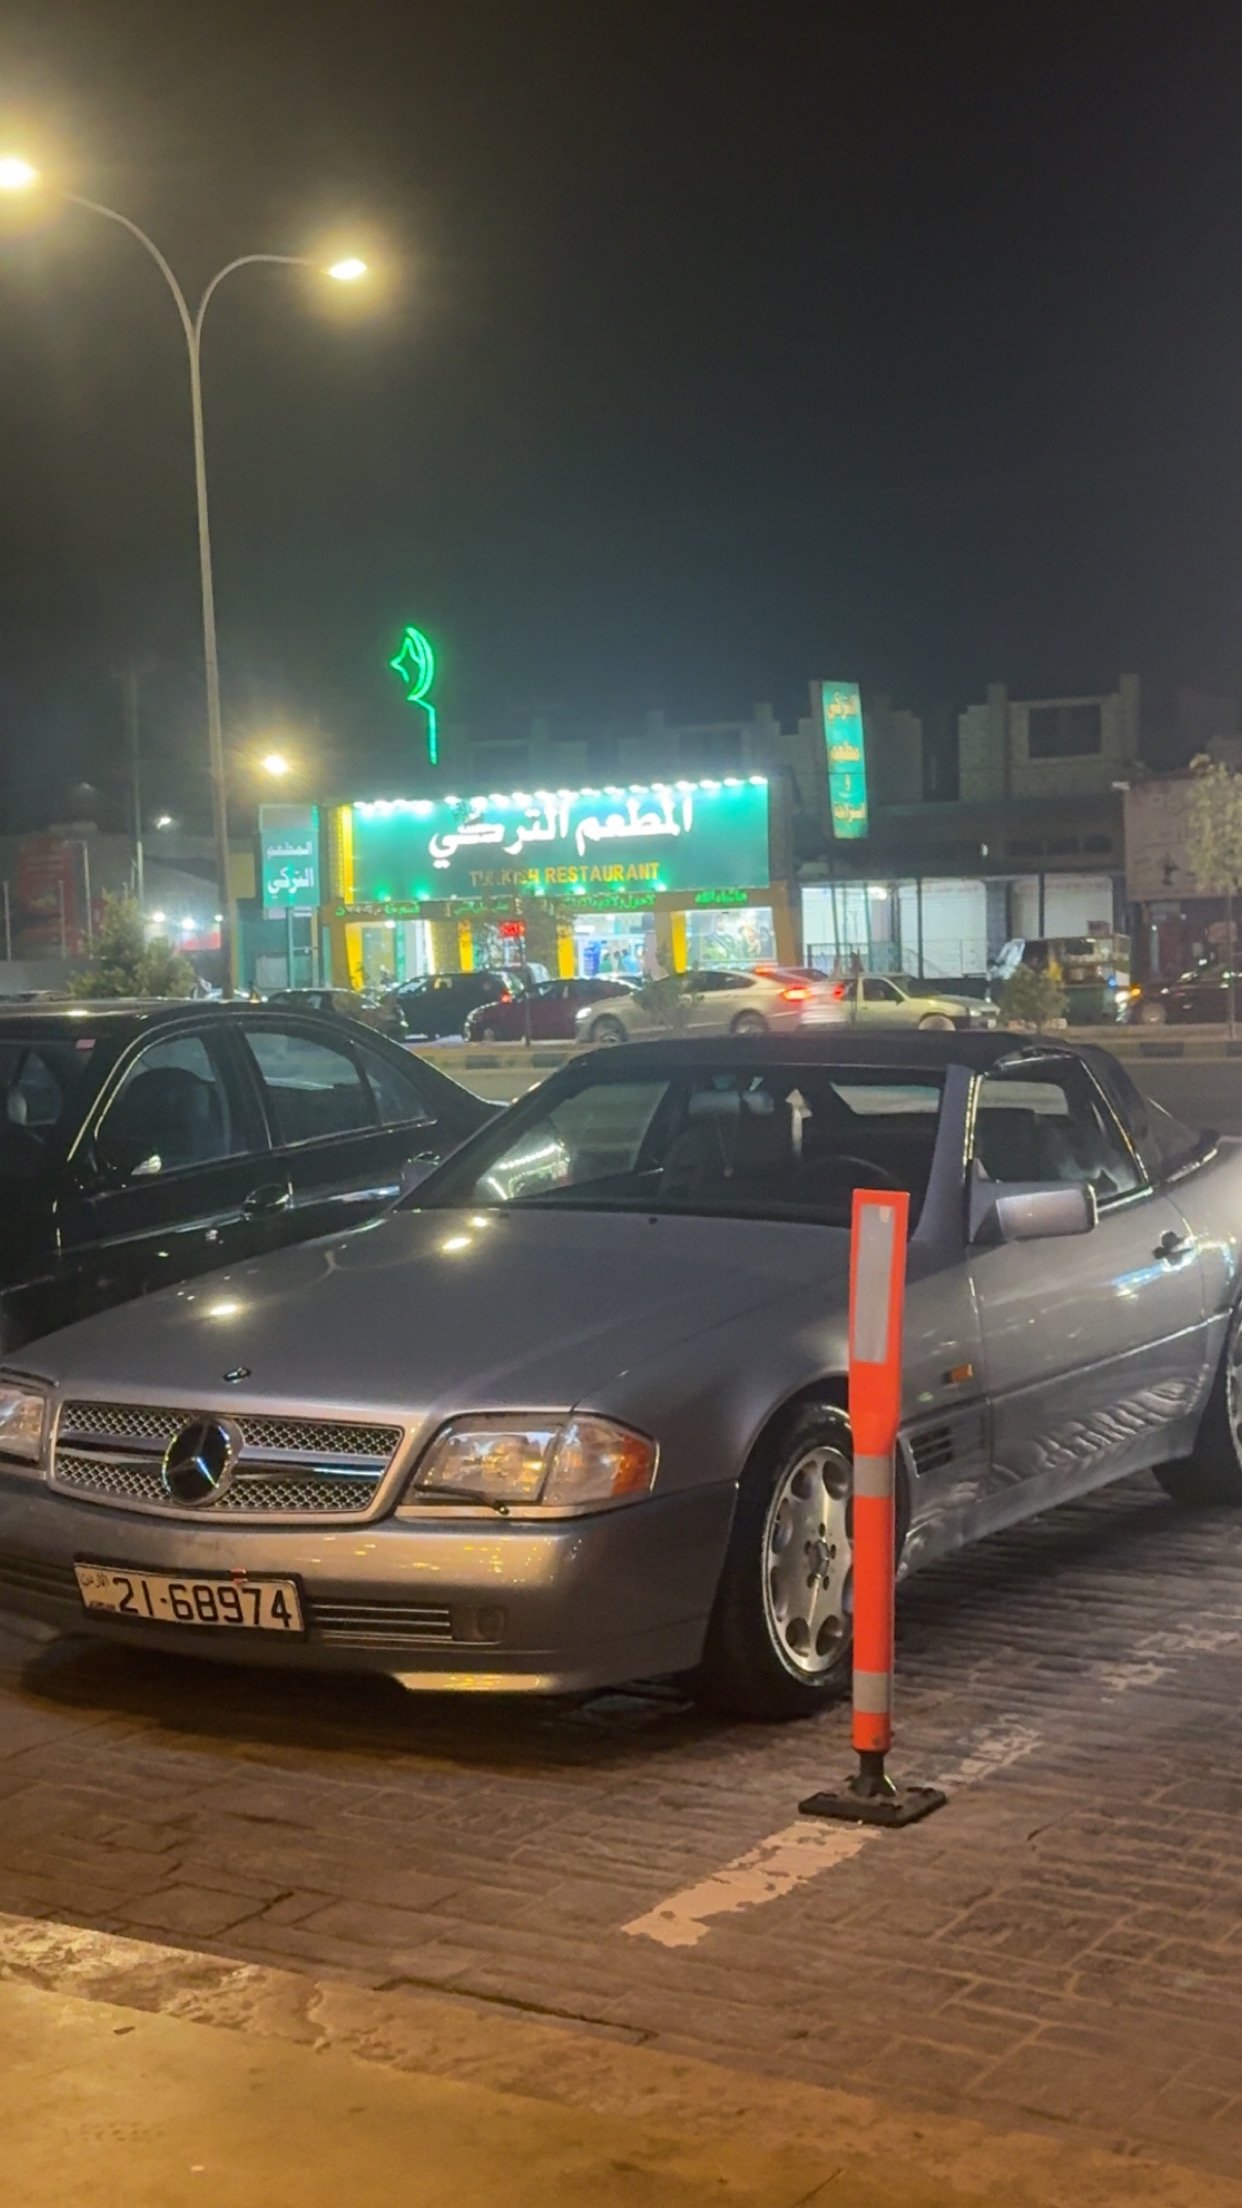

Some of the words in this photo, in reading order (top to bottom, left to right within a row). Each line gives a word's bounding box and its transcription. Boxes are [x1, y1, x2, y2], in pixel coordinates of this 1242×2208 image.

[428, 800, 572, 869] التركي
[575, 790, 693, 857] المطعم
[267, 867, 315, 900] التركي
[544, 862, 660, 881] RESTAURANT
